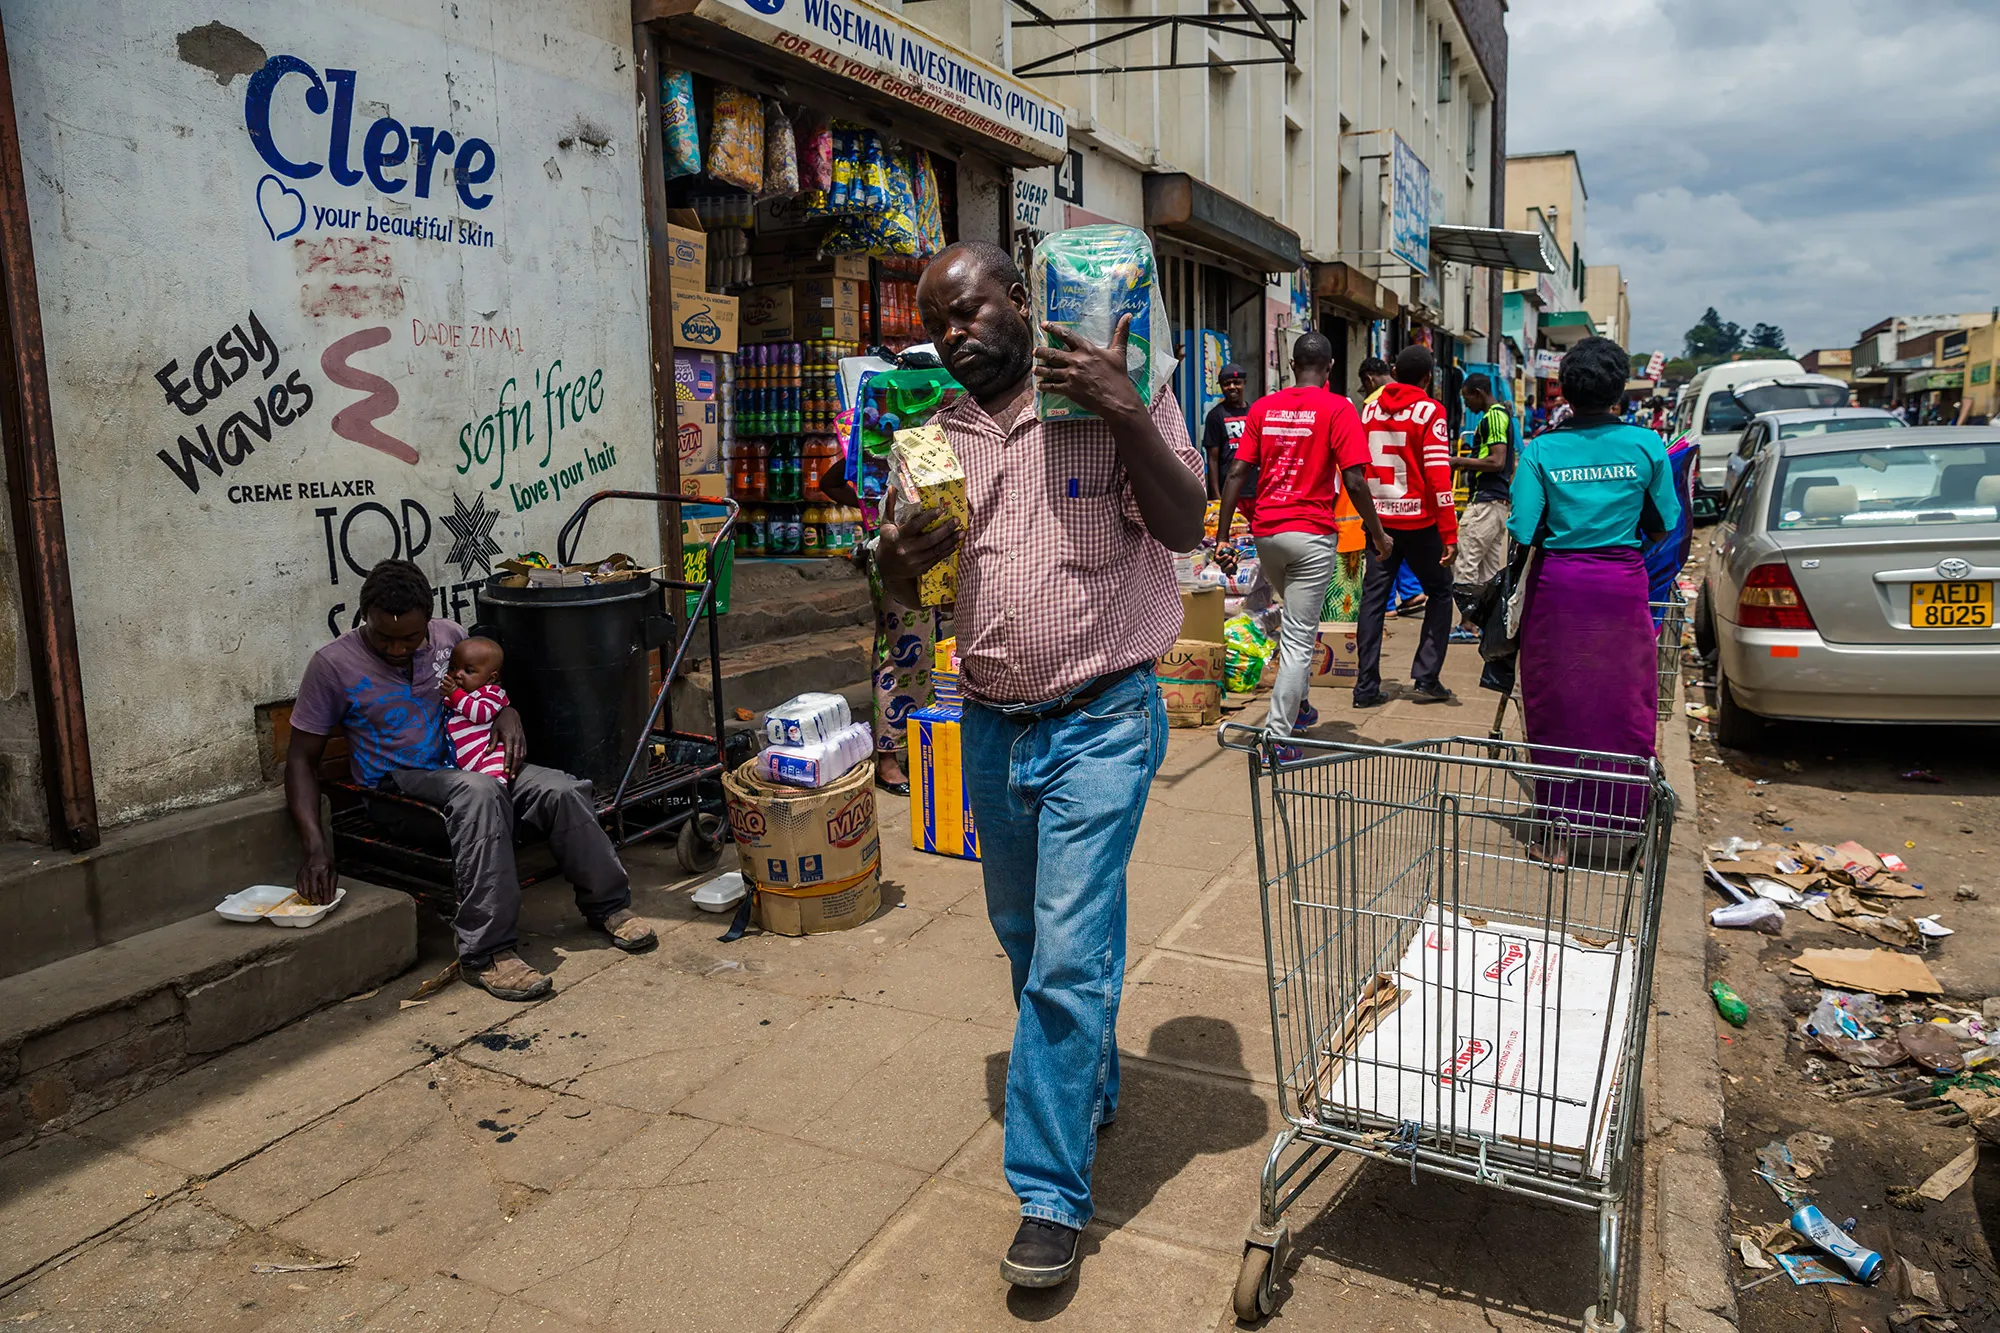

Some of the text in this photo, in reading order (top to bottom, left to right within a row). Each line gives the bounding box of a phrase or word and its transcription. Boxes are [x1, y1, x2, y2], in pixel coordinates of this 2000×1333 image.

[804, 0, 895, 61] WISEMAN
[900, 37, 1003, 111] INVESTMENTS
[773, 31, 1024, 147] FOR ALL YOUR GROCERY REQUIREMENTS
[244, 54, 496, 210] Clere
[1015, 179, 1048, 207] SUGAR
[1057, 152, 1075, 199] 4
[312, 204, 495, 248] your beautiful skin
[1016, 202, 1041, 226] SALT
[412, 318, 464, 347] DADIE
[153, 309, 280, 417] Easy
[156, 368, 314, 495] Waves
[678, 428, 702, 453] MA
[508, 441, 617, 513] Love your hair
[1367, 430, 1408, 499] 5
[1549, 464, 1638, 483] VERIMARK
[227, 479, 377, 505] CREME RELAXER
[314, 498, 432, 586] TOP
[1925, 605, 1986, 625] 8025
[1931, 583, 1980, 604] AED
[1161, 652, 1197, 667] LUX
[827, 791, 875, 844] MAQ
